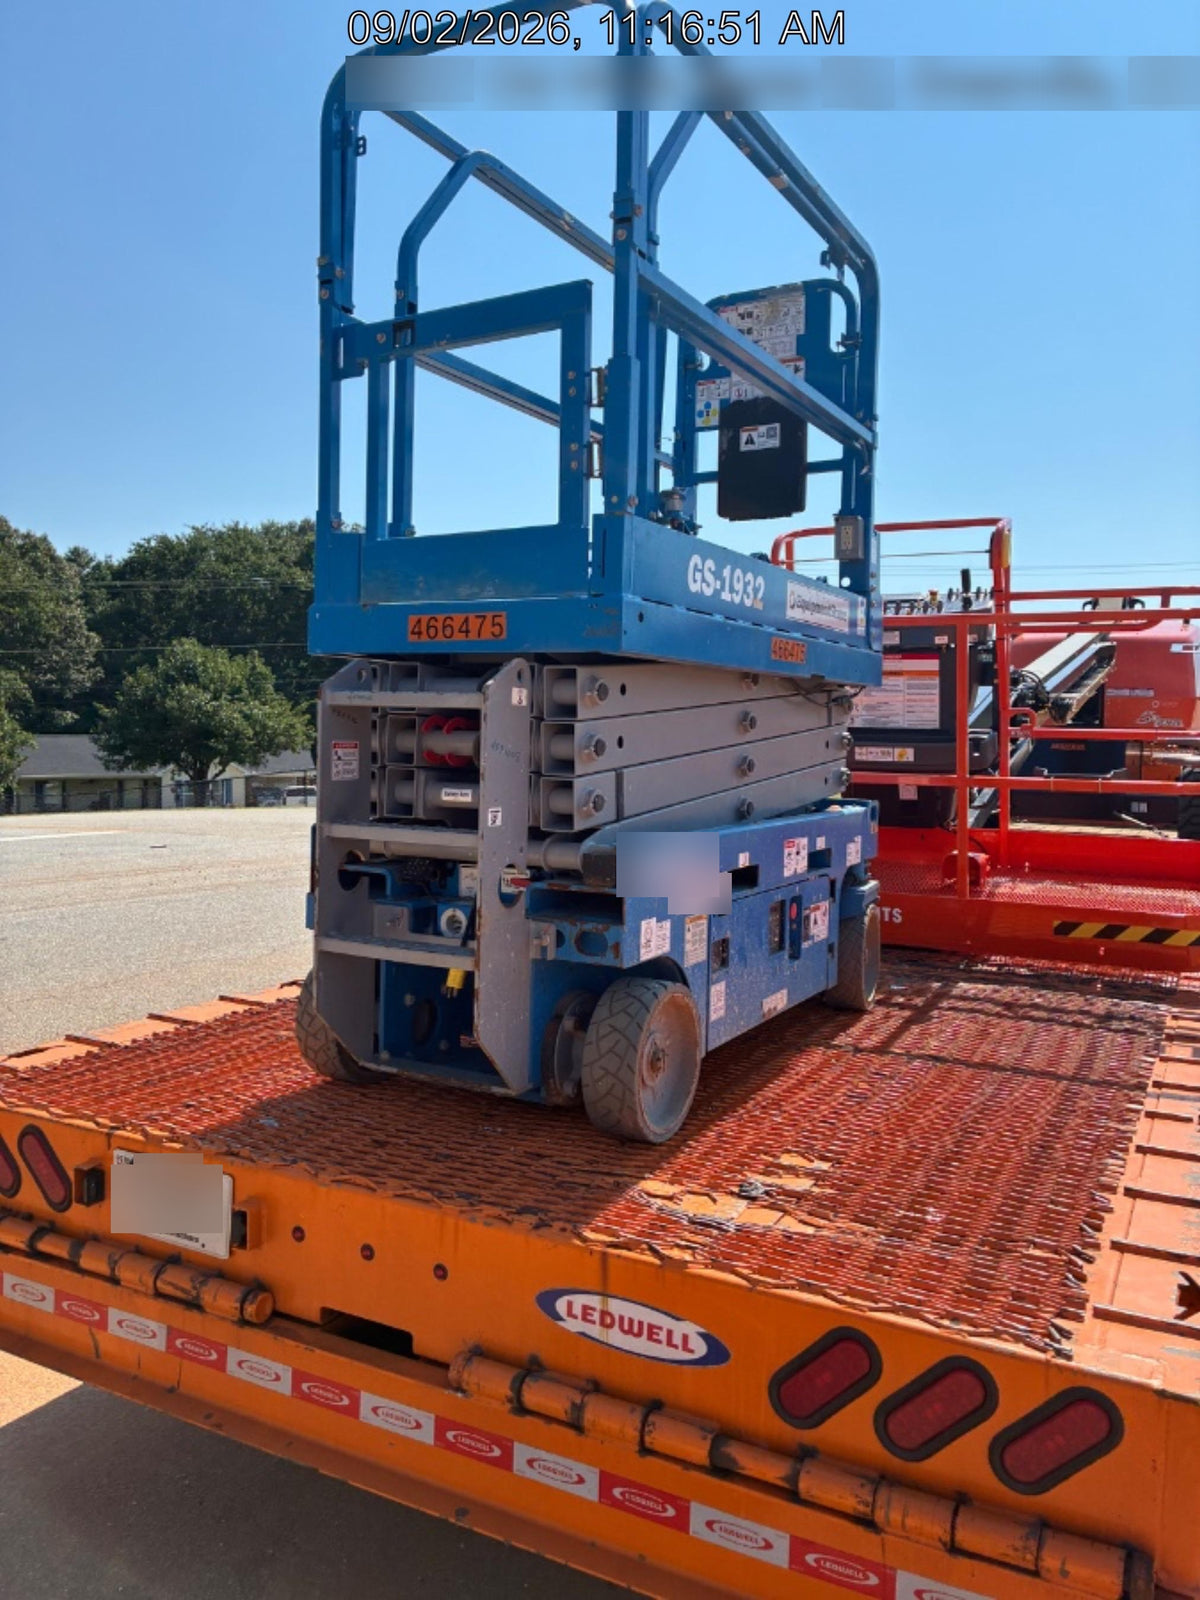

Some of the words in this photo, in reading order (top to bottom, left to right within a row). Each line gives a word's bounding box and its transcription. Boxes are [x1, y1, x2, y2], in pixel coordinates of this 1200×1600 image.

[687, 554, 765, 611] GS-1932
[410, 613, 505, 640] 466475
[566, 1299, 695, 1355] LEDWELL
